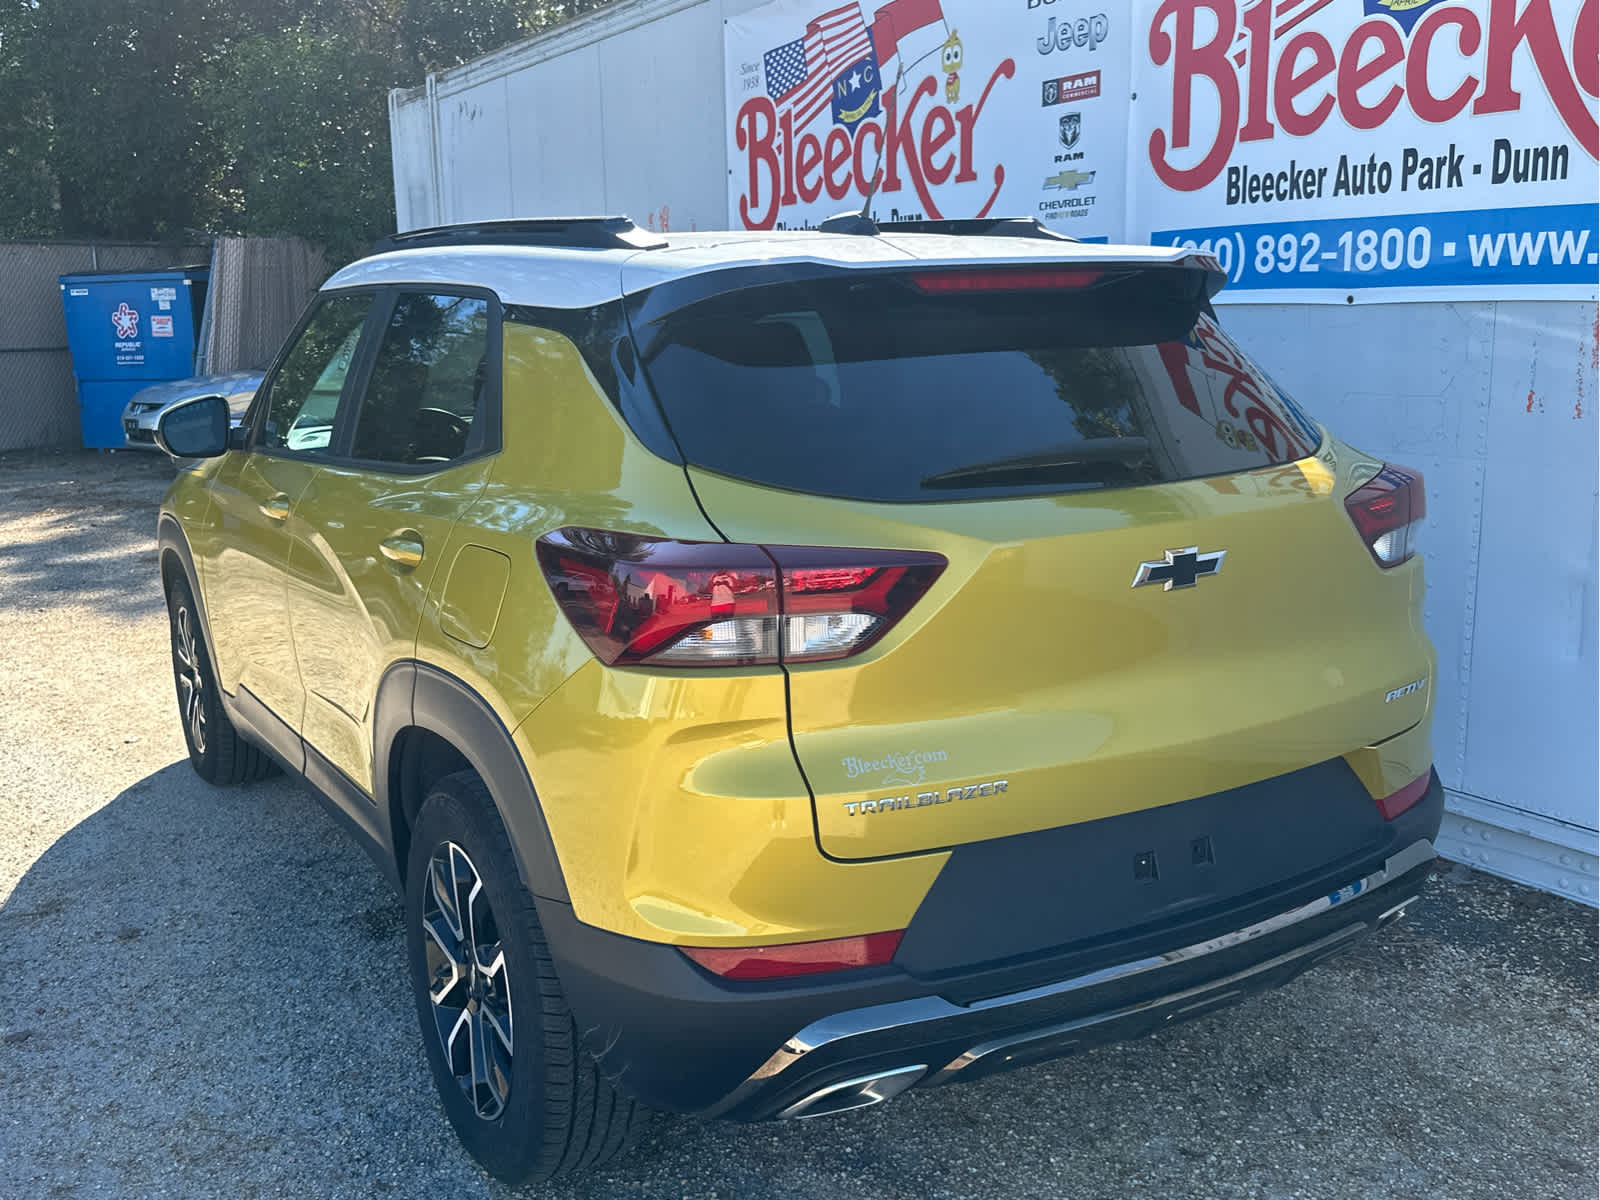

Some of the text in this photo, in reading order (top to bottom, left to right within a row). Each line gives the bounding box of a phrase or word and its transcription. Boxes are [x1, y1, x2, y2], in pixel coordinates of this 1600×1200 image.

[1037, 13, 1108, 55] Jeep
[1062, 75, 1097, 91] RAM
[1054, 151, 1084, 163] RAM
[1226, 160, 1327, 205] Bleecker
[1333, 154, 1392, 197] Auto
[1401, 143, 1464, 192] Park
[1491, 138, 1569, 185] Dunn
[1039, 196, 1097, 210] CHEVROLET
[1255, 226, 1431, 274] 892-1800
[844, 780, 1009, 817] TRAILBLAZER
